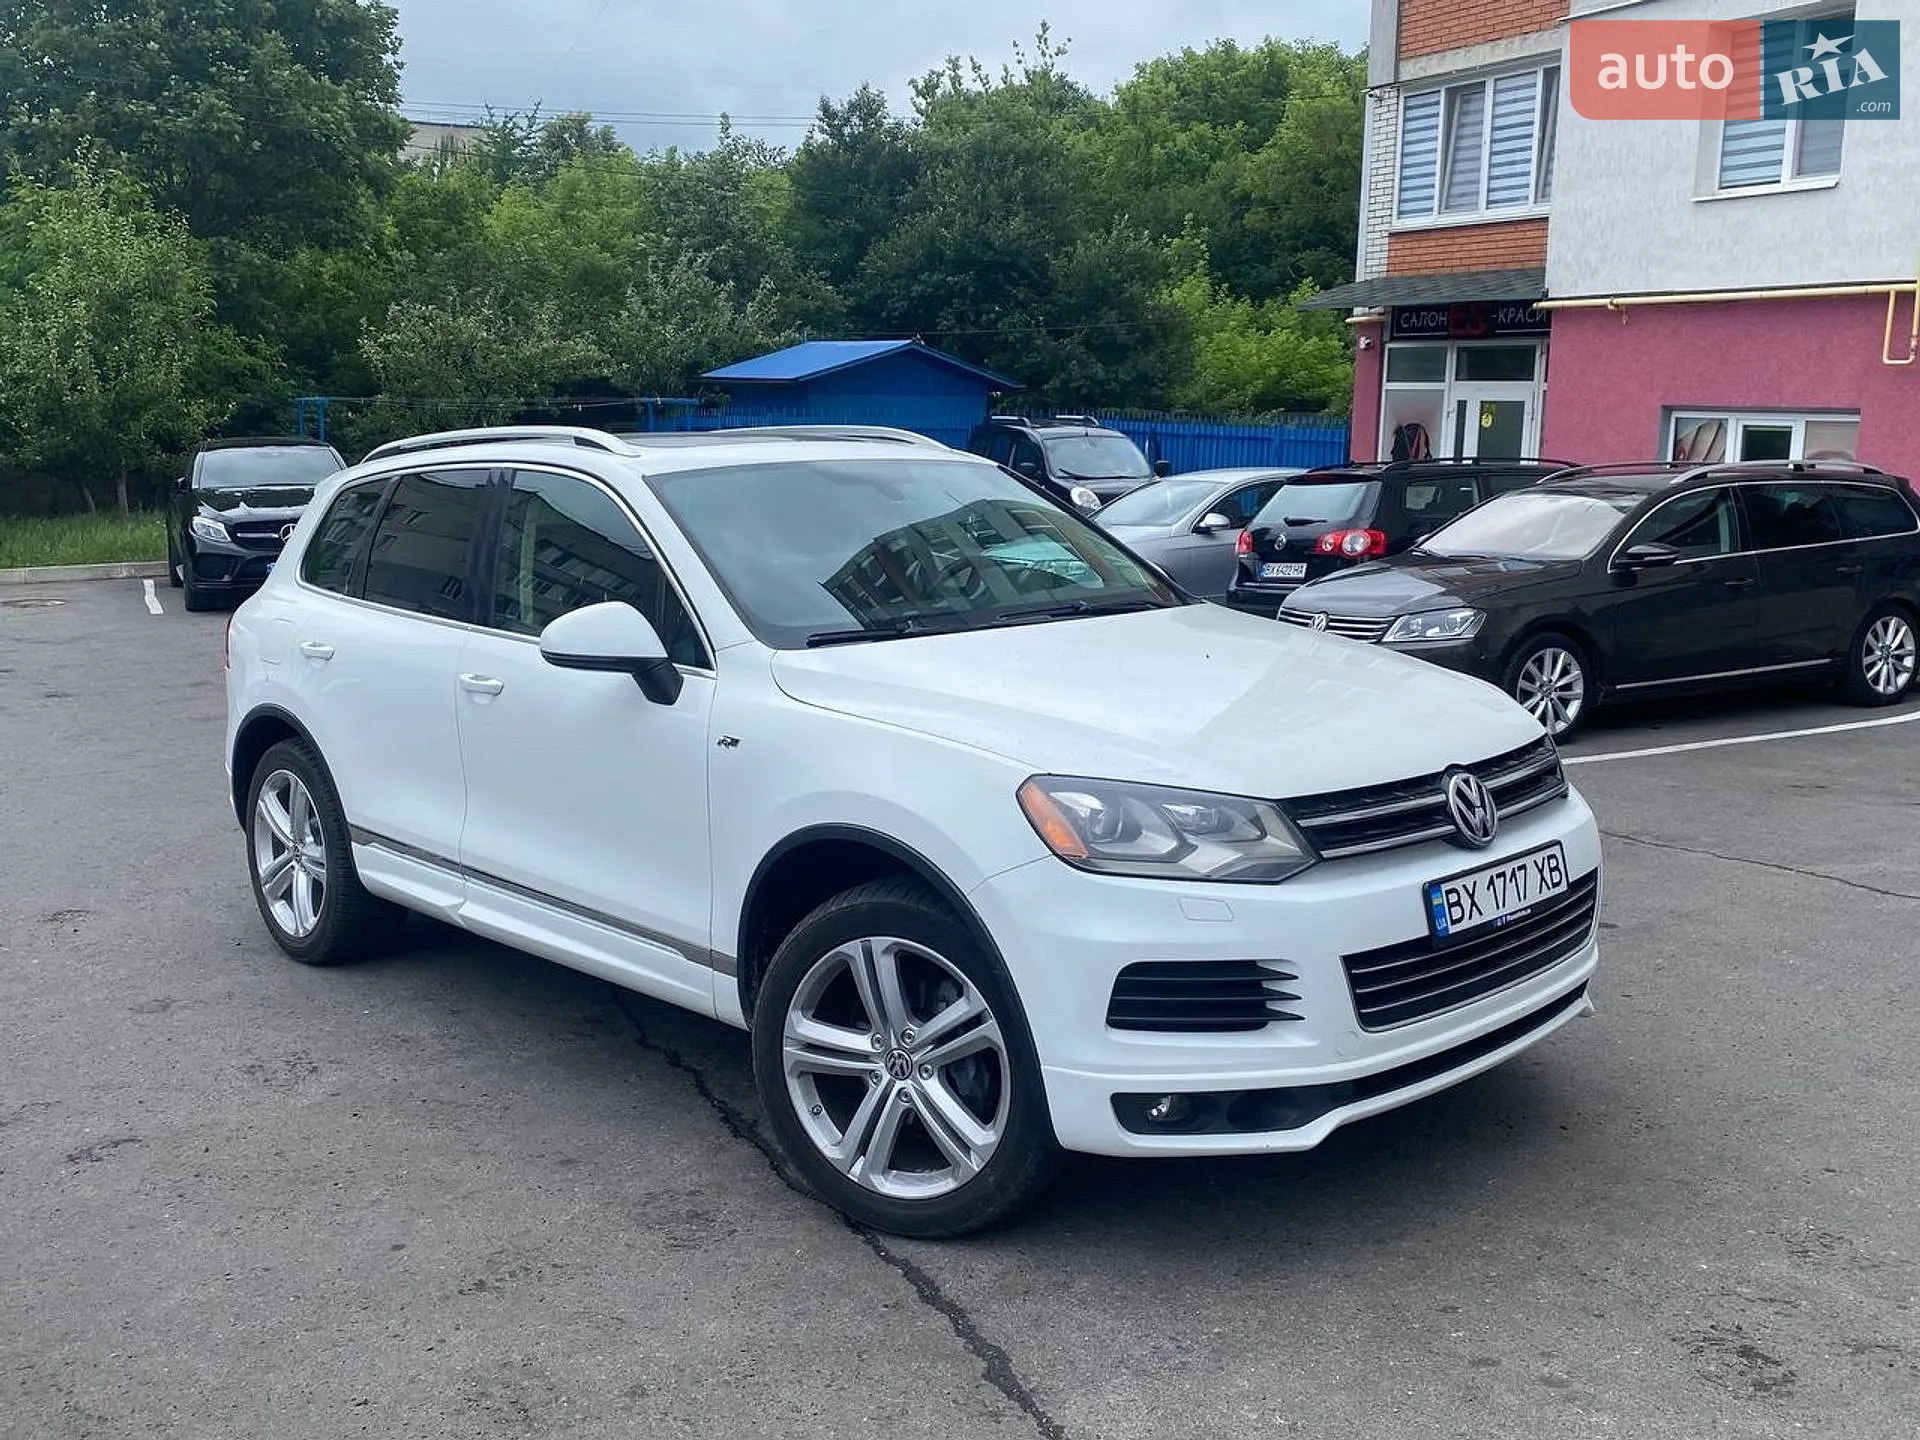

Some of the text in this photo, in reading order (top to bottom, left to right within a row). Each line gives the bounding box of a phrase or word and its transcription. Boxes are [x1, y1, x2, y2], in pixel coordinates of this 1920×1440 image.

[1400, 311, 1447, 328] САЛОН
[1444, 880, 1483, 926] BX
[1486, 863, 1527, 910] 1717
[1533, 853, 1563, 894] XB
